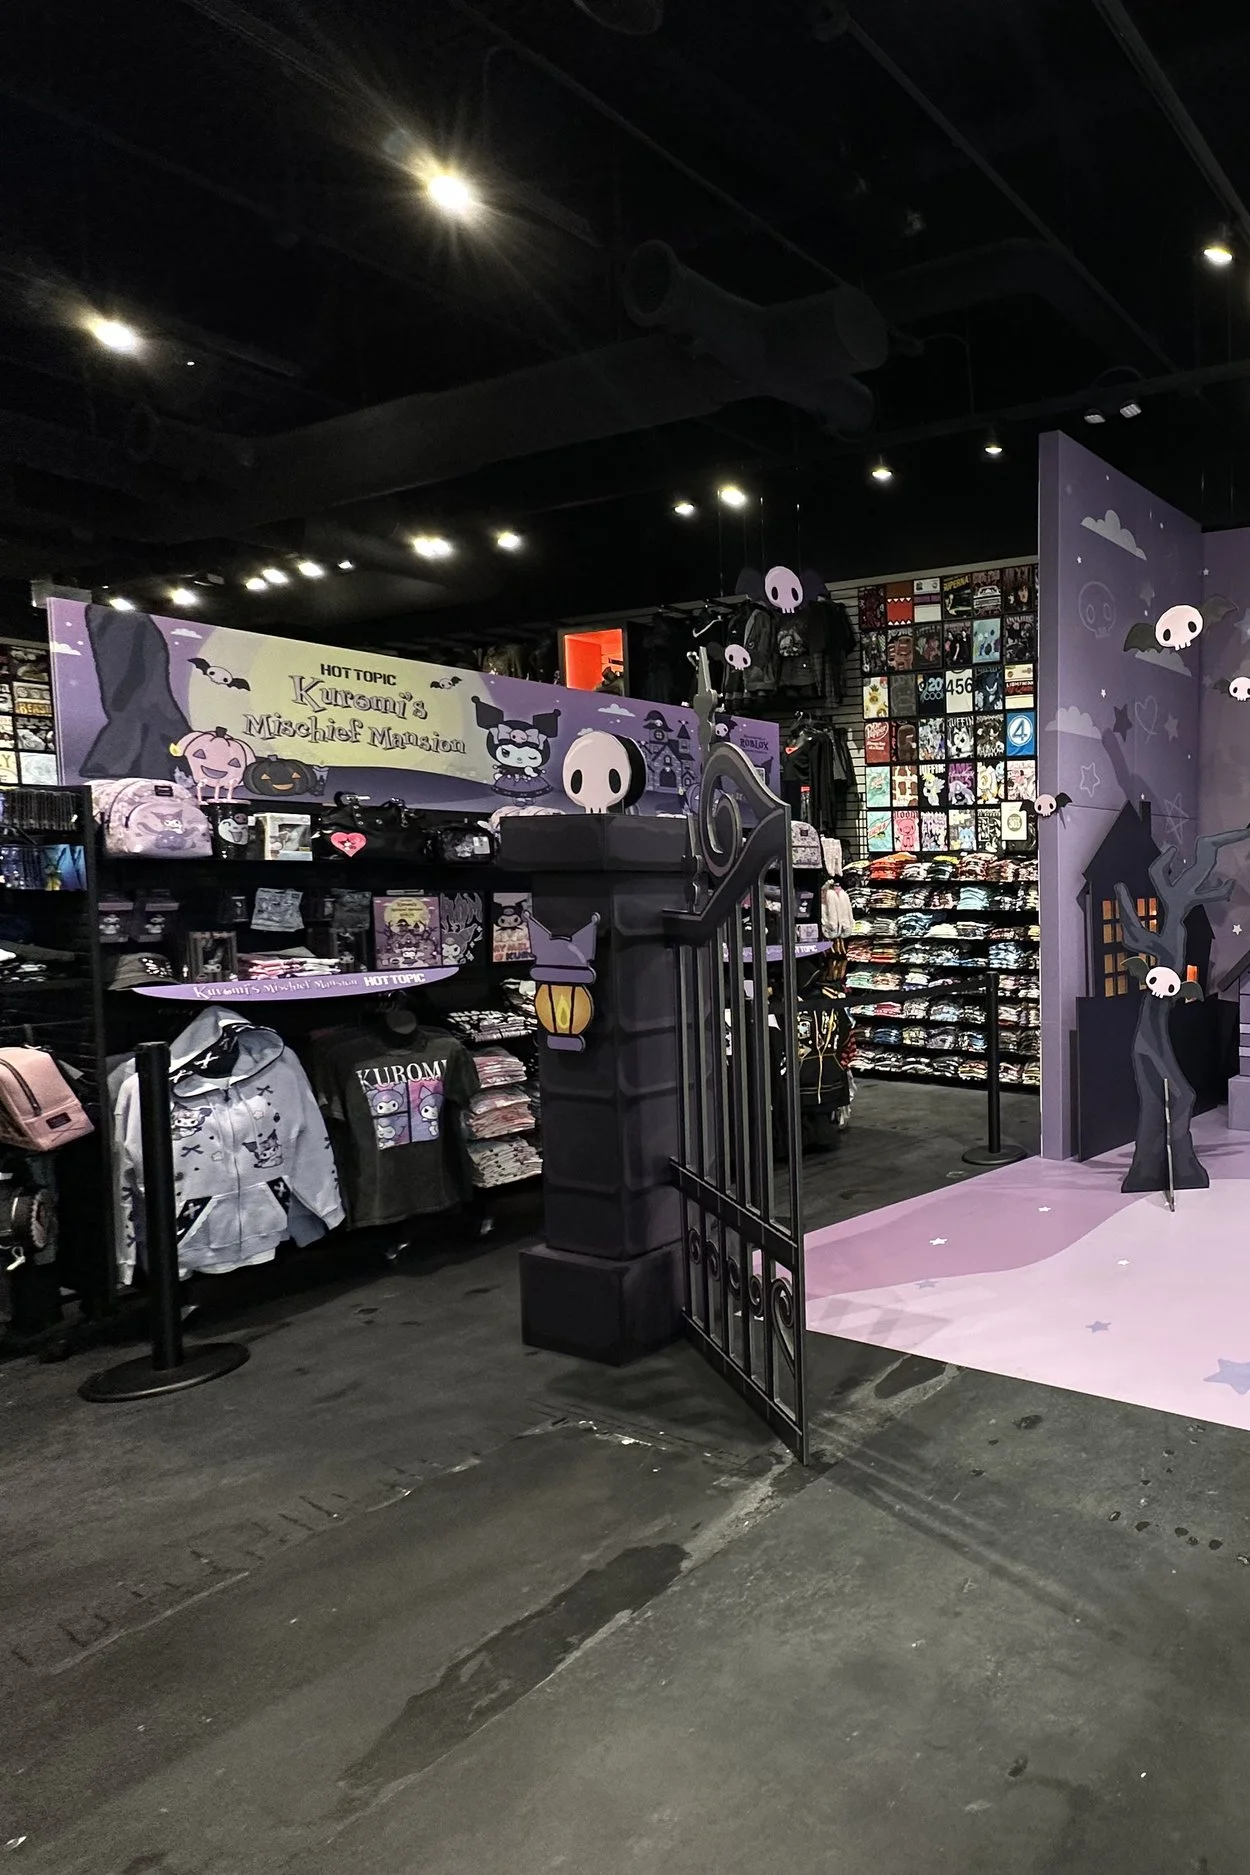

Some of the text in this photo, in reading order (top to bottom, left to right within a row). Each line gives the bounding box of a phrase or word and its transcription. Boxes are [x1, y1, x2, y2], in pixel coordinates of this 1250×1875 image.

[320, 663, 397, 686] HOT TOPIC
[946, 677, 973, 695] 456
[289, 675, 428, 719] Kuromi's
[242, 712, 466, 754] Mischief Mansion
[740, 739, 769, 750] ROBLOX
[192, 983, 260, 1000] Kuromi's
[263, 978, 312, 995] Mischief
[363, 976, 390, 988] HOT
[390, 973, 426, 986] TOPIC
